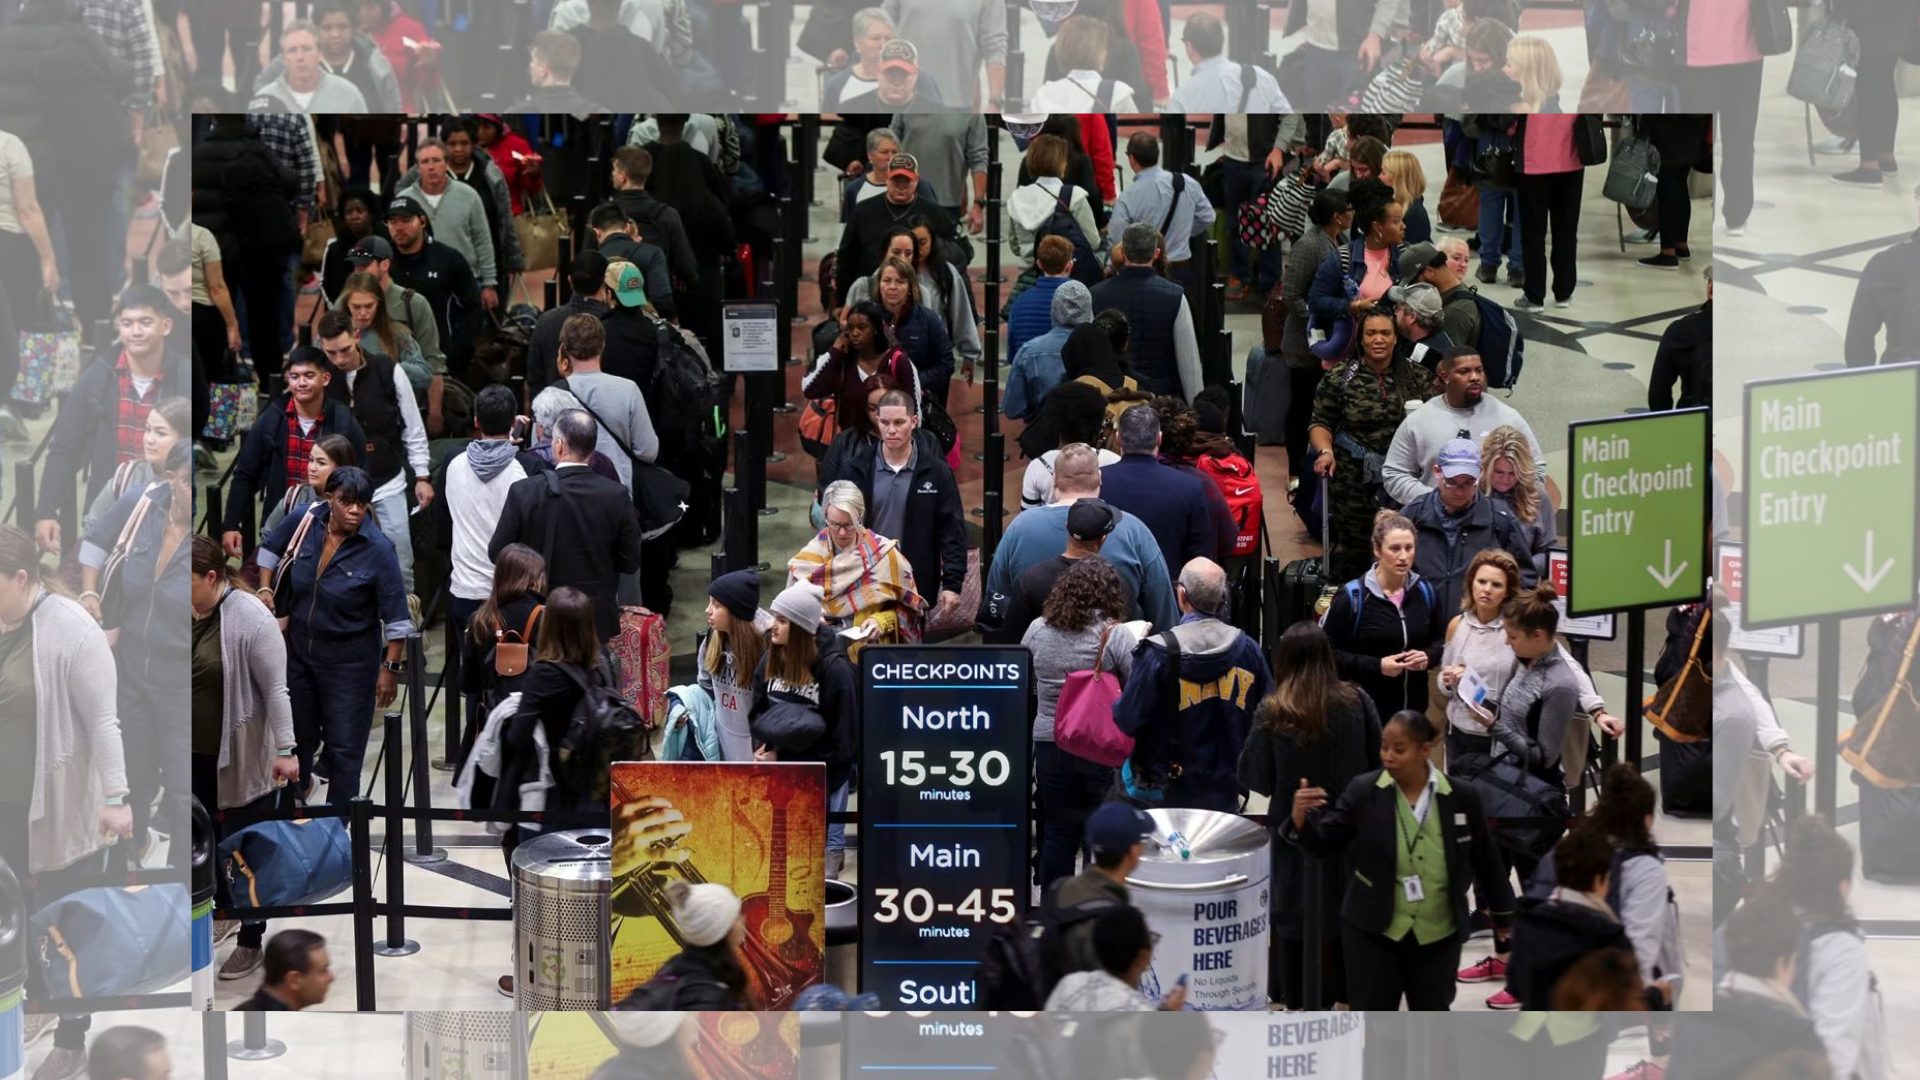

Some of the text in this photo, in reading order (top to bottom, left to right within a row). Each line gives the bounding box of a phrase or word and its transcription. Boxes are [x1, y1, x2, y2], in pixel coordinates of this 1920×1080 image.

[1760, 397, 1821, 434] Main
[1582, 434, 1630, 463] Main
[1760, 432, 1902, 480] Checkpoint
[1581, 462, 1693, 500] Checkpoint
[1759, 490, 1827, 526] Entry
[1580, 509, 1635, 536] Entry
[872, 663, 1020, 680] CHECKPOINTS
[902, 705, 990, 730] North
[880, 750, 1010, 786] 15-30
[919, 787, 971, 800] minutes
[910, 843, 980, 868] Main
[873, 888, 1016, 923] 30-45
[1194, 900, 1237, 921] POUR
[918, 924, 970, 938] minutes
[1194, 913, 1267, 946] BEVERAGES
[1193, 950, 1233, 971] HERE
[1194, 978, 1207, 986] No
[1194, 988, 1230, 998] Through
[919, 1021, 984, 1036] minutes
[1268, 1011, 1359, 1047] BEVERAGES
[1267, 1052, 1318, 1079] HERE
